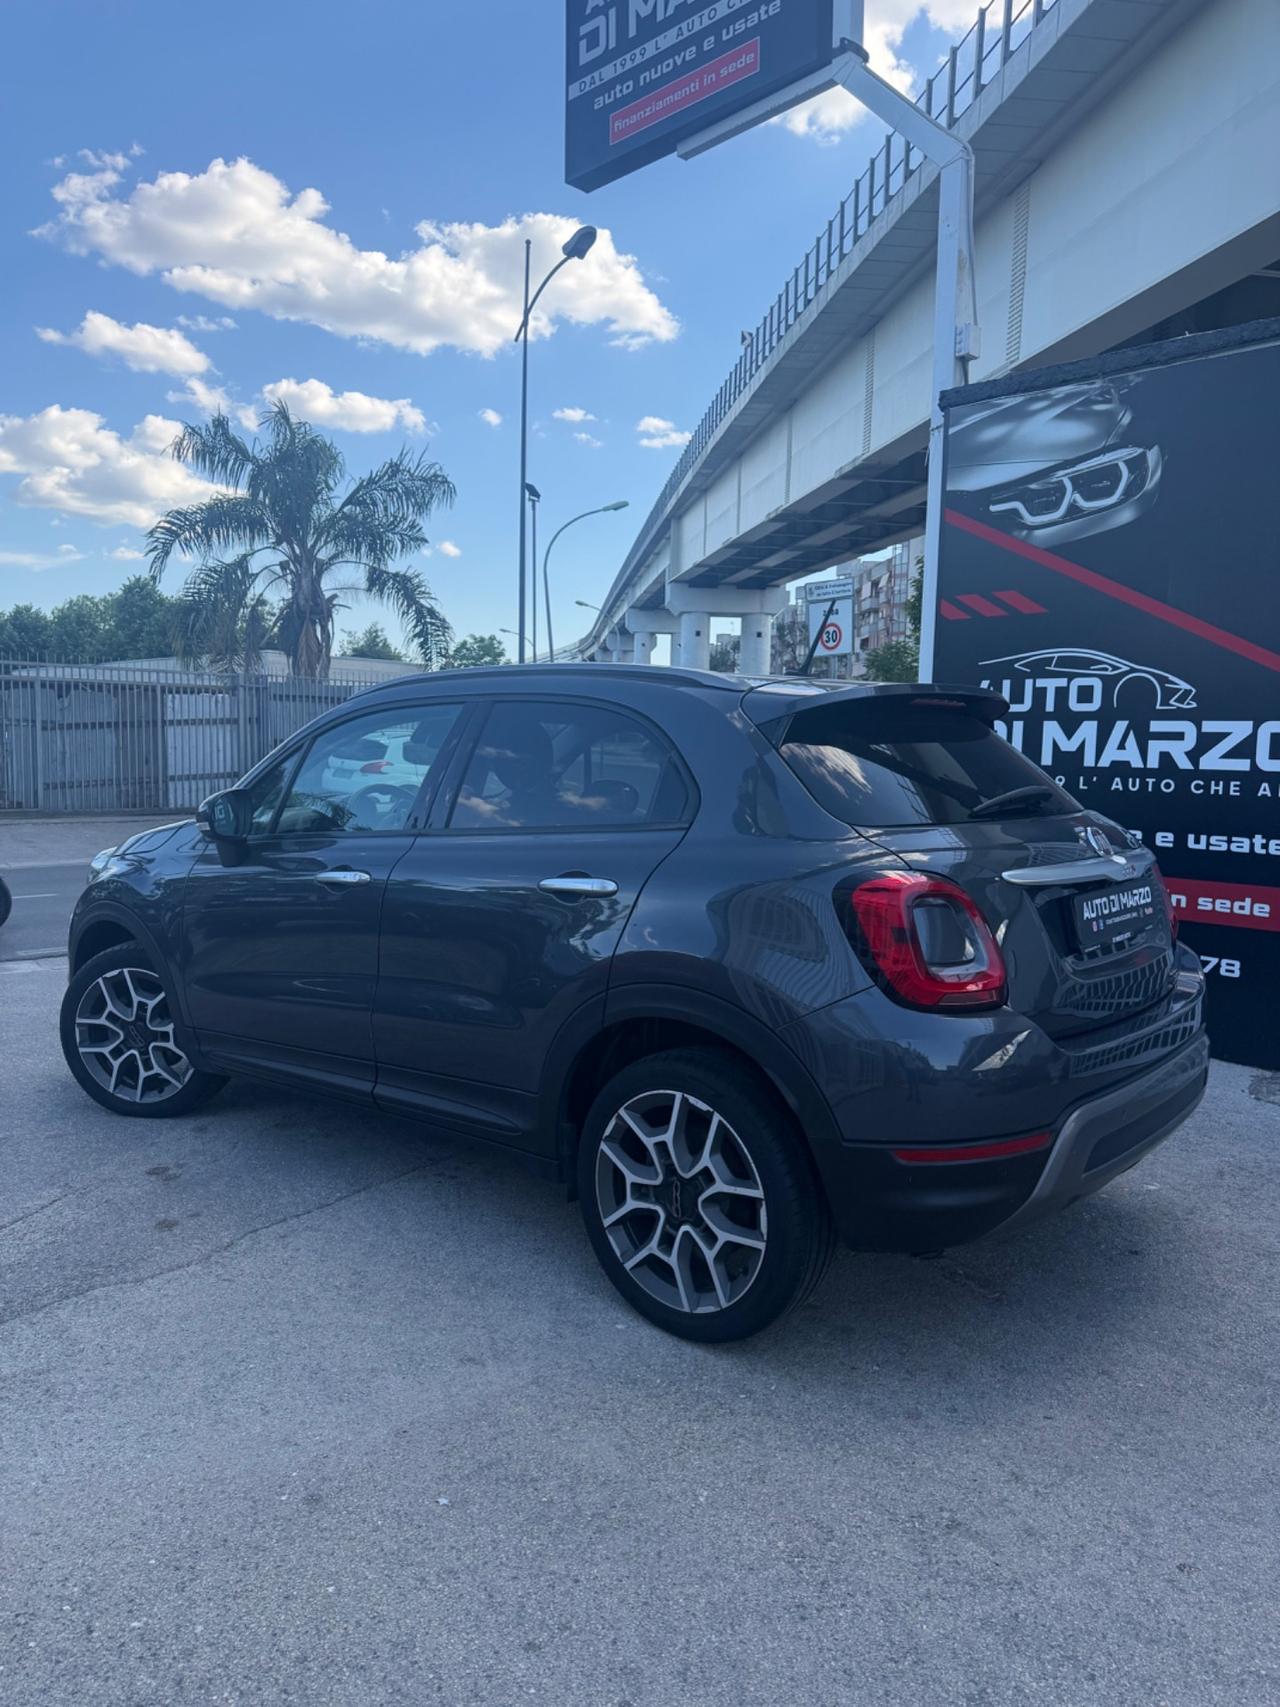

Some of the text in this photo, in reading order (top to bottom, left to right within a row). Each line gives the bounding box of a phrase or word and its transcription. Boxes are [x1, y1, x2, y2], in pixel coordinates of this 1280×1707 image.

[579, 6, 616, 66] DI
[579, 71, 606, 93] DAL
[613, 46, 647, 74] 1999
[676, 7, 718, 40] AUTO
[594, 80, 633, 110] auto
[640, 46, 697, 86] nuove
[703, 35, 715, 51] e
[722, 0, 781, 41] usate
[614, 52, 755, 133] finanziamenti in sede
[825, 630, 838, 643] 30
[980, 677, 1102, 713] UTO
[1111, 777, 1175, 793] AUTO
[1190, 780, 1241, 796] CHE
[1155, 831, 1175, 848] e
[1187, 833, 1280, 856] usate
[1083, 897, 1110, 920] AUTO
[1109, 893, 1120, 913] DI
[1120, 886, 1152, 910] MARZO
[1197, 897, 1271, 918] sede
